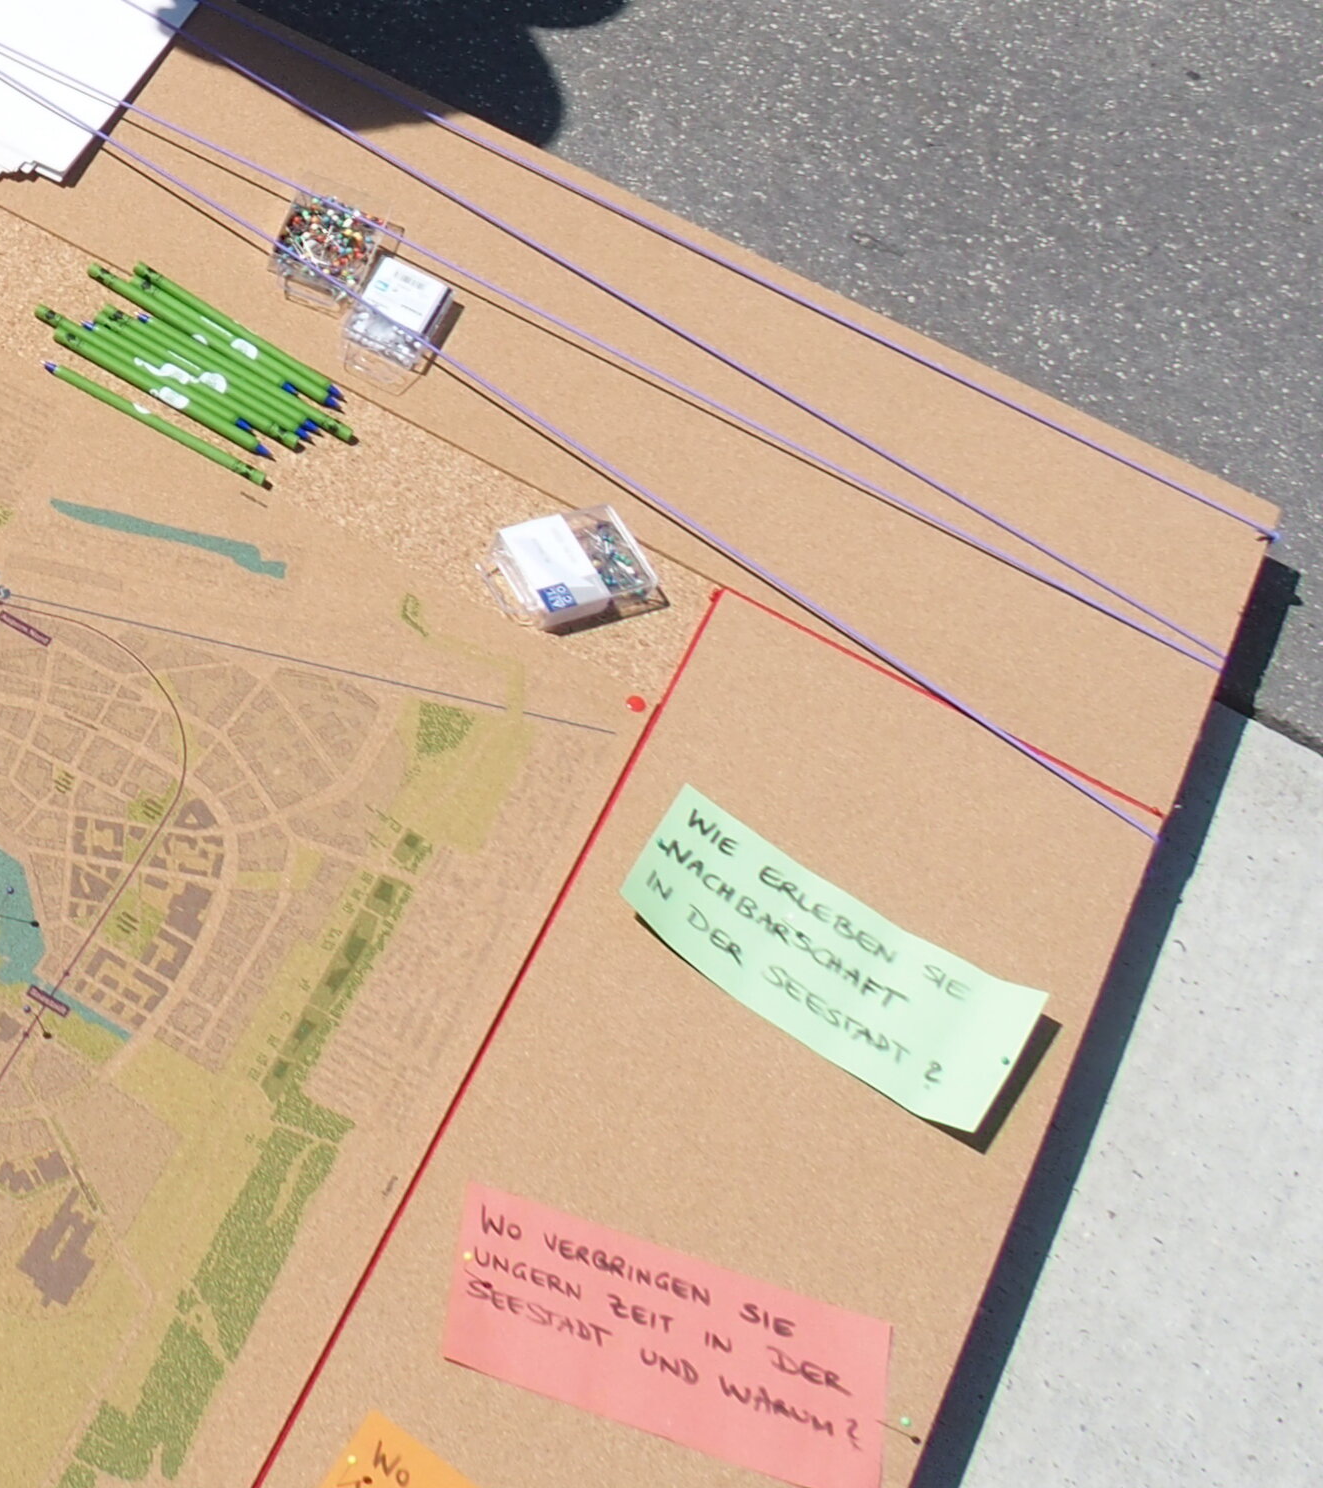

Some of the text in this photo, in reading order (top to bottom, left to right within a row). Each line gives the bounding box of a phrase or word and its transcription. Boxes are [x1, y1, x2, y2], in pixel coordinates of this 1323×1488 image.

[645, 869, 673, 902] IN
[686, 903, 744, 967] DER
[762, 964, 912, 1064] SEESTADT
[663, 839, 911, 1009] NACHBARSCHAFT
[686, 808, 973, 1003] WIE ERLEBEN SIE
[466, 1278, 614, 1350] SEESTADT
[639, 1347, 700, 1386] UND
[473, 1245, 852, 1396] UNGERN ZEIT IN DER
[543, 1231, 711, 1308] VERBRINGEN
[739, 1301, 796, 1340] SIE
